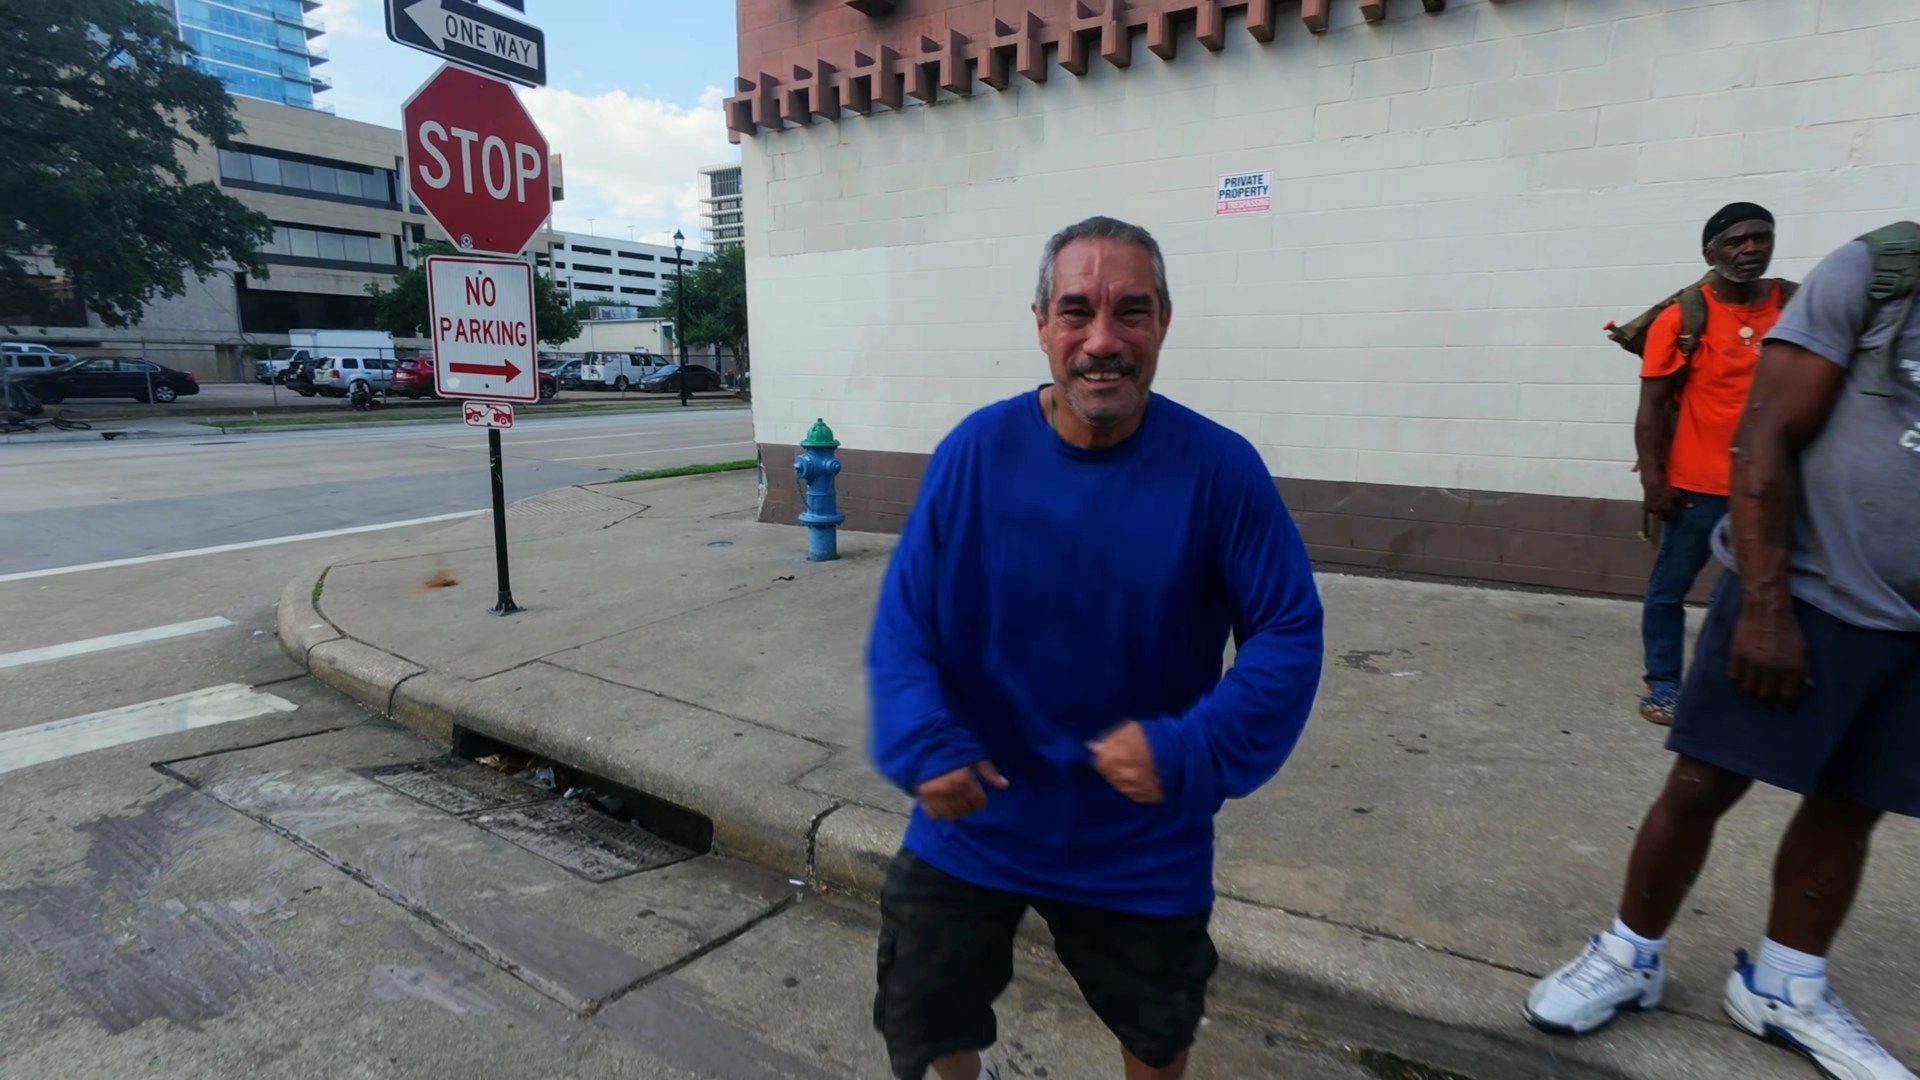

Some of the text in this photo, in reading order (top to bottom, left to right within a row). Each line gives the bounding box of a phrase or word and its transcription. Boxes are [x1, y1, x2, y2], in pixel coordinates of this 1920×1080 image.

[445, 14, 531, 63] ONE WAY
[418, 120, 542, 203] STOP
[1218, 185, 1269, 200] PROPERTY
[1224, 174, 1264, 188] PRIVATE
[465, 276, 496, 307] NO
[440, 317, 527, 347] PARKING
